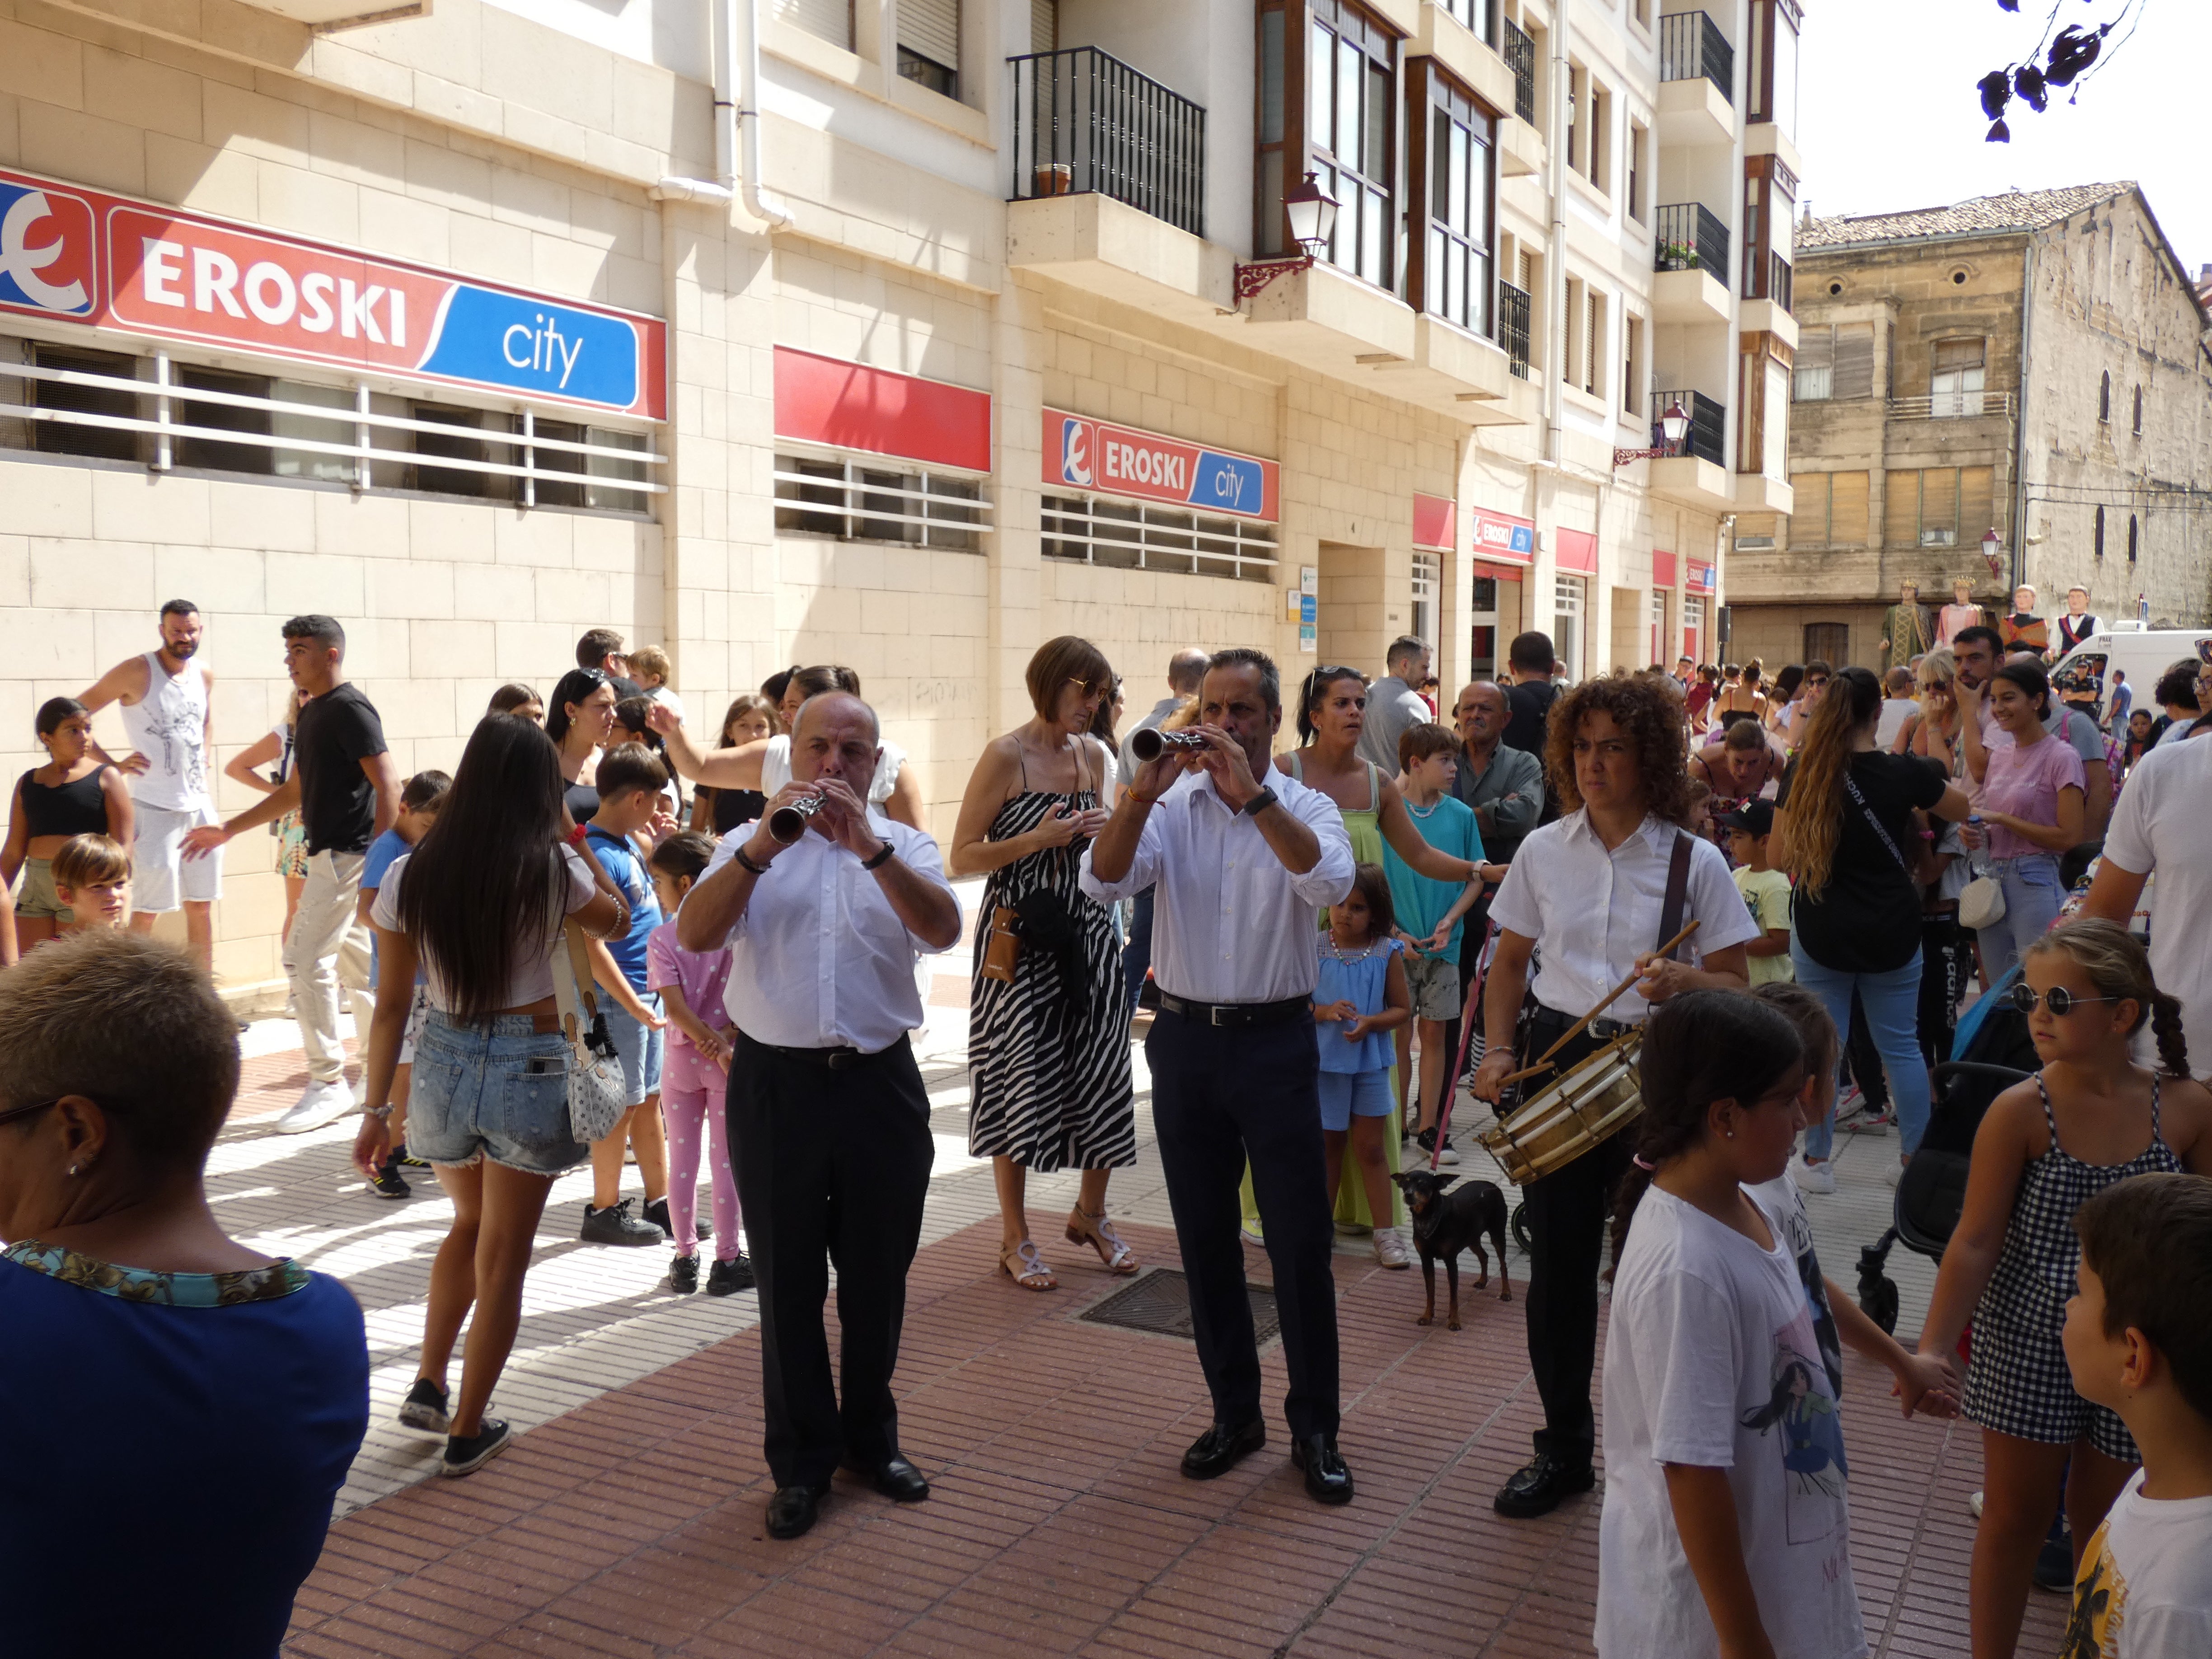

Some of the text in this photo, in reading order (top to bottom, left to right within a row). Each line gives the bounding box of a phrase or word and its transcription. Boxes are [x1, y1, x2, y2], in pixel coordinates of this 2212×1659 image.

[142, 237, 583, 389] EROSKI city
[1106, 441, 1243, 506] EROSKI city
[1484, 523, 1509, 544] EROSKI
